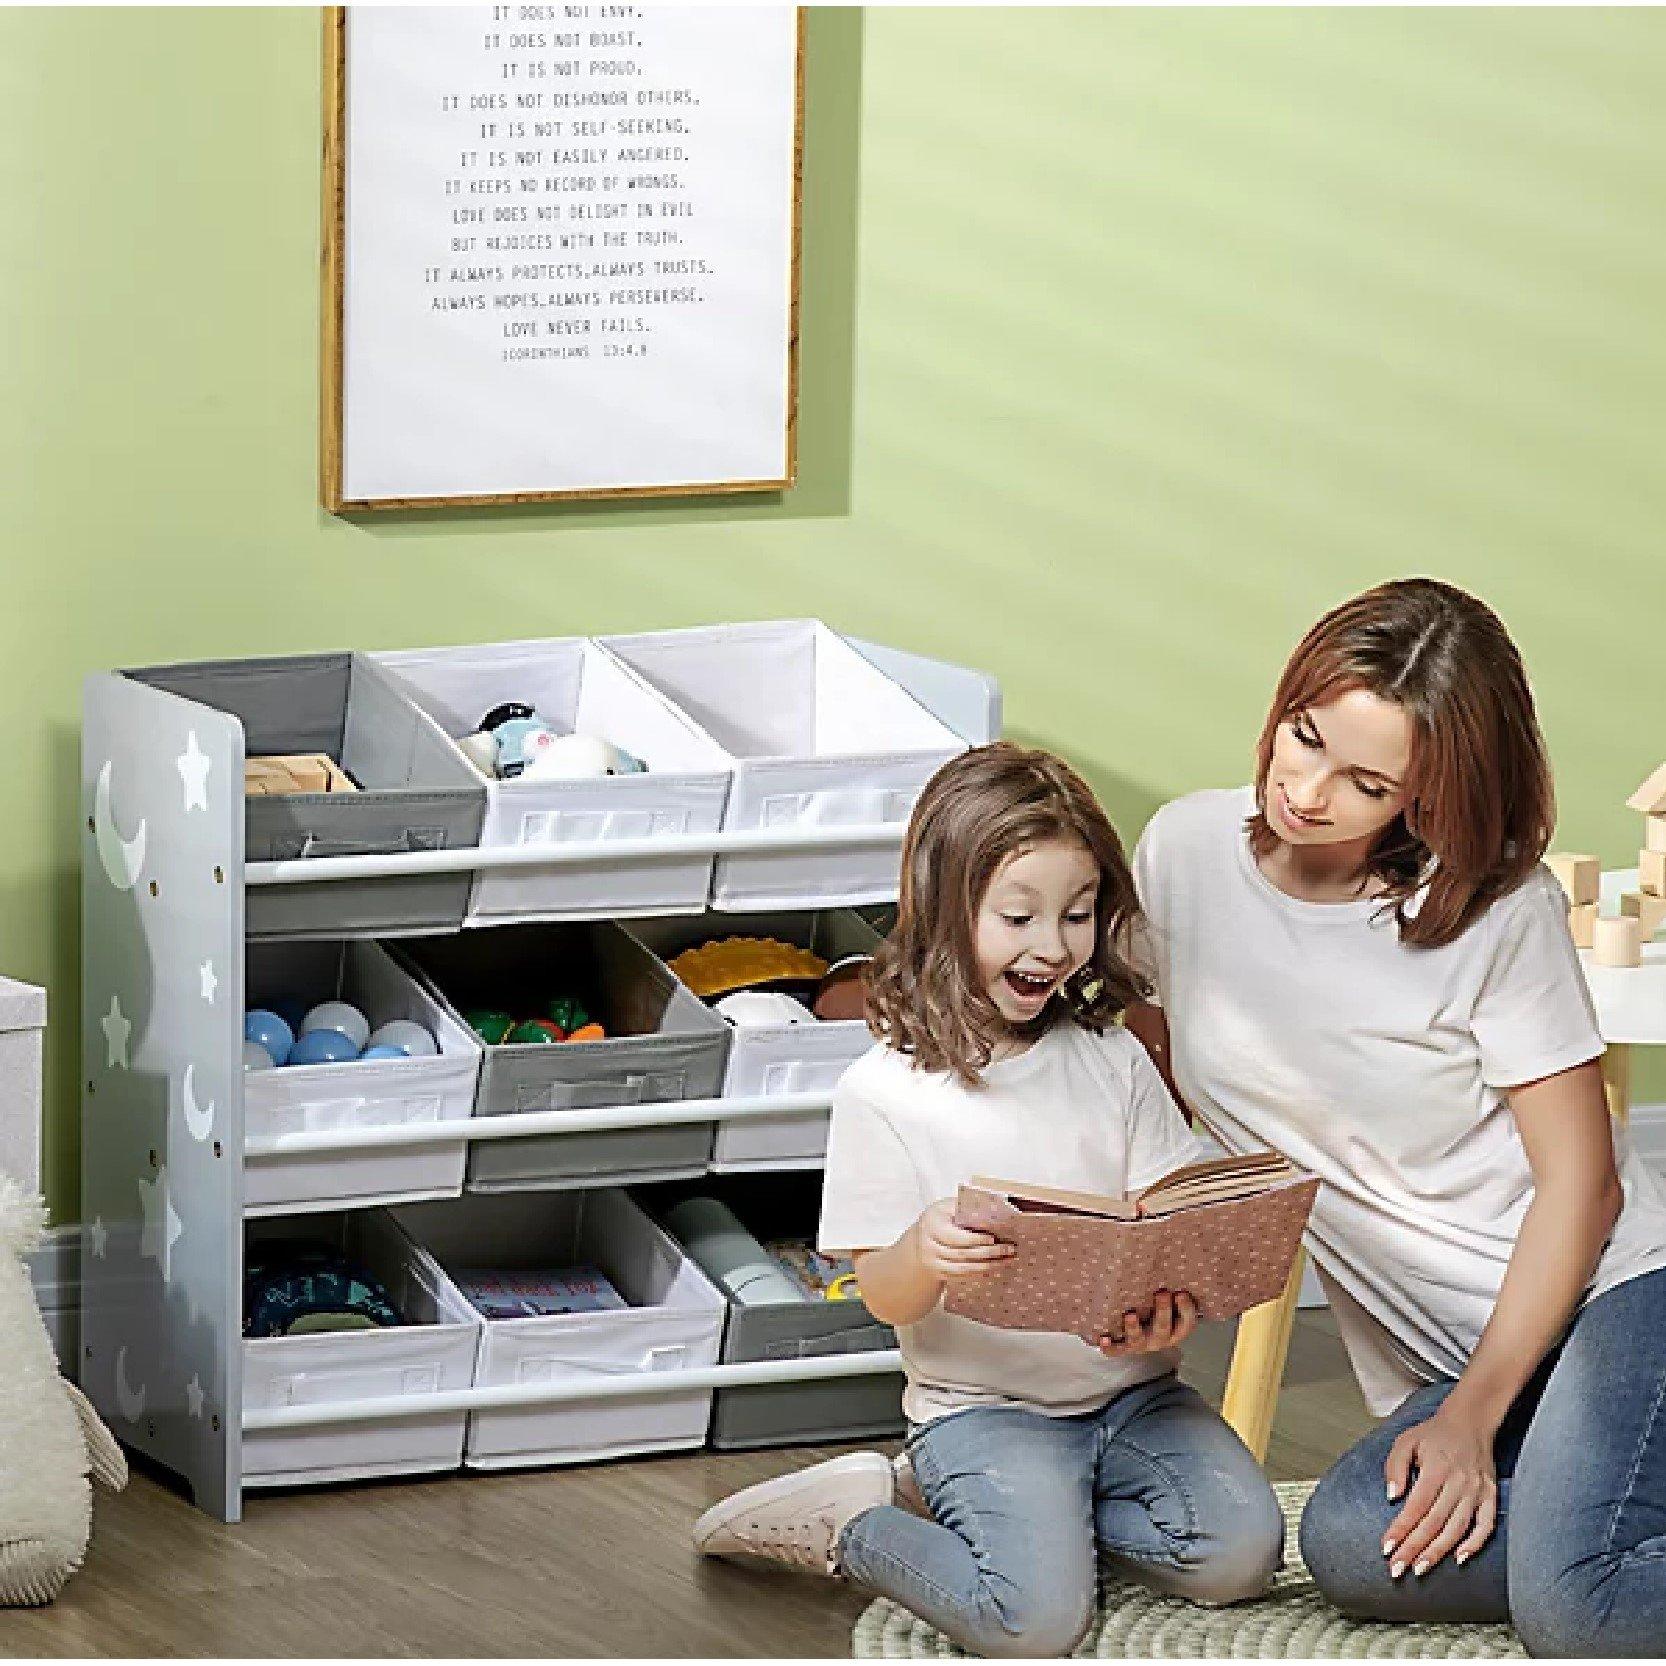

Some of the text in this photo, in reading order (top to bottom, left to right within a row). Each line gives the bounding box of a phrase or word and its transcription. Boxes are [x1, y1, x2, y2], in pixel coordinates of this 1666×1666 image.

[493, 6, 510, 21] IT
[518, 6, 554, 21] DOES
[563, 6, 592, 17] NOT
[485, 34, 500, 50] IT
[510, 32, 546, 49] DOES
[554, 32, 583, 47] NOT
[501, 64, 518, 78] IT
[529, 61, 546, 78] IS
[554, 61, 579, 76] NOT
[443, 96, 460, 111] IT
[468, 94, 507, 110] DOES
[515, 92, 543, 108] NOT
[554, 91, 627, 108] DISHONOR
[480, 122, 496, 139] IT
[507, 122, 528, 138] IS
[535, 122, 563, 136] NOT
[461, 152, 476, 166] IT
[488, 152, 507, 167] IS
[515, 149, 544, 166] NOT
[554, 147, 607, 165] EASILY
[446, 180, 460, 195] IT
[470, 178, 511, 193] KEEPS
[520, 177, 538, 193] NO
[545, 176, 598, 193] RECORD
[602, 176, 618, 191] OF
[453, 202, 693, 224] LOVE DOES NOT DELIGHT IN EVIL
[451, 238, 476, 251] BUT
[560, 233, 595, 249] WITH
[602, 232, 627, 247] THE
[426, 268, 440, 282] IT
[448, 264, 504, 282] ALWAYS
[432, 295, 488, 311] ALWAYS
[504, 320, 538, 338] LOVE
[546, 320, 590, 336] NEVER
